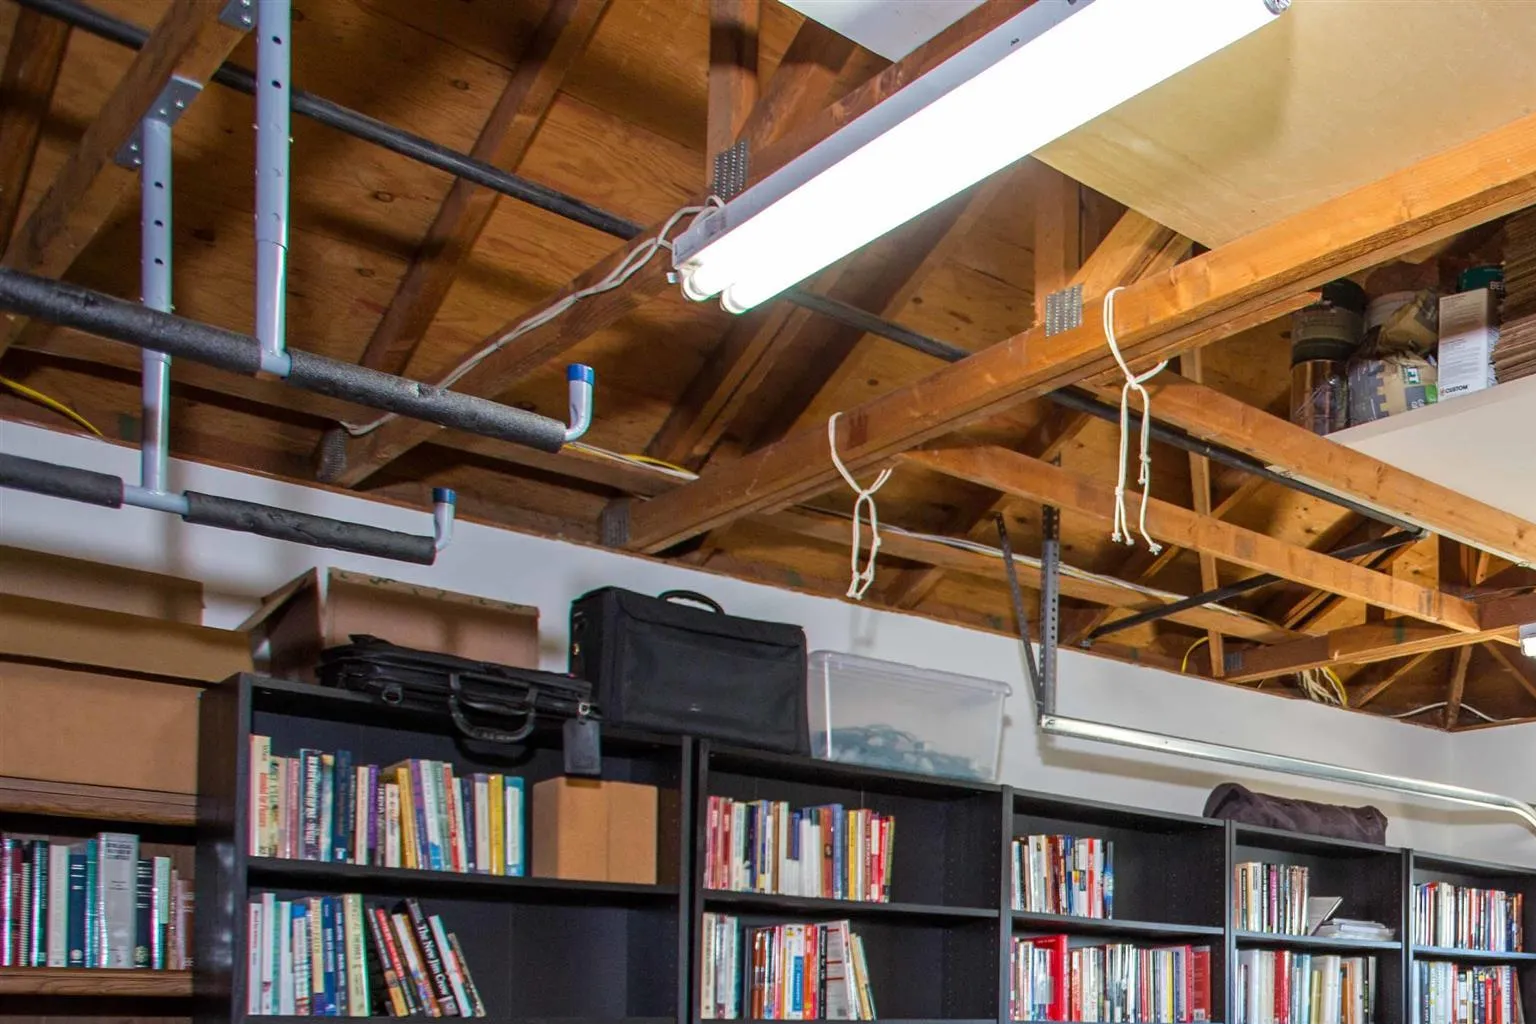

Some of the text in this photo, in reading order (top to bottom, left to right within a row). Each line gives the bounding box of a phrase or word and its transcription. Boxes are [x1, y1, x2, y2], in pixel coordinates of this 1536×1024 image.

[1445, 384, 1469, 395] CUSTOM
[417, 925, 450, 995] The New Jim Crow
